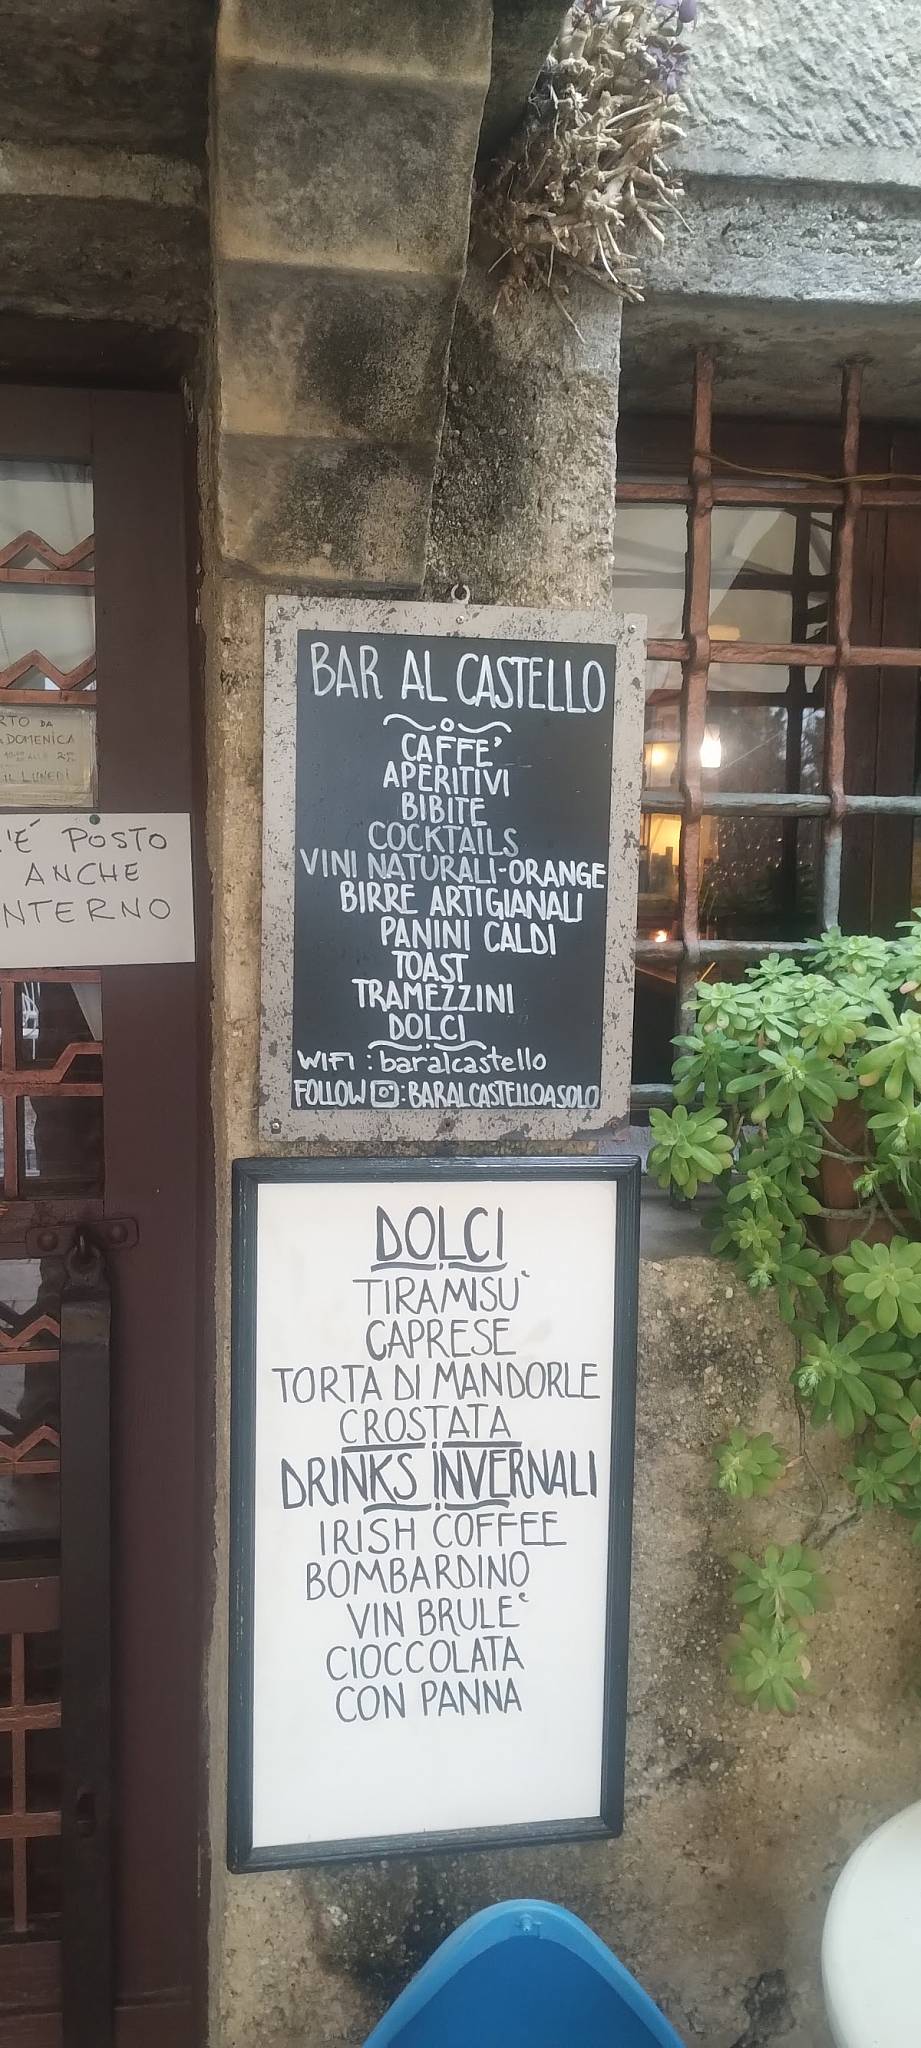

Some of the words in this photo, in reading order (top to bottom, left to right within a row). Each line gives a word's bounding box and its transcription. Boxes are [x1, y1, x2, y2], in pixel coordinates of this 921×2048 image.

[310, 641, 383, 699] BAR
[401, 649, 448, 702] AL
[456, 653, 606, 713] CASTELLO
[382, 761, 510, 797] APERITIVI
[402, 792, 488, 826] BIBITE
[61, 827, 167, 852] POSTO
[368, 821, 520, 857] COCKTAILS
[25, 862, 140, 886] ANCHE
[300, 849, 358, 878] VINI
[340, 881, 418, 914] BIRRE
[429, 886, 583, 923] ARTIGIANALI
[381, 916, 471, 951] PANINI
[484, 921, 556, 955] CALDI
[392, 951, 469, 983] TOAST
[352, 979, 514, 1014] TRAMEZZINI
[389, 1013, 467, 1042] DOLCI
[297, 1050, 355, 1071] WIFI
[293, 1078, 366, 1107] FOLLOW
[376, 1205, 504, 1263] DOLCI
[366, 1318, 517, 1361] CAPRESE
[272, 1364, 383, 1404] TORTA
[394, 1364, 420, 1401] DI
[432, 1361, 601, 1401] MANDORLE
[339, 1403, 511, 1444] CROSTATA
[281, 1452, 418, 1510] DRINKS
[433, 1449, 598, 1499] INVERNALI
[320, 1517, 416, 1556] IRISH
[432, 1511, 567, 1548] COFFEE
[306, 1551, 530, 1601] BOMBARDINO
[347, 1600, 404, 1639] VIN
[326, 1636, 525, 1681] CIOCCOLATA
[335, 1681, 406, 1723] CON
[421, 1678, 523, 1717] PANNA
